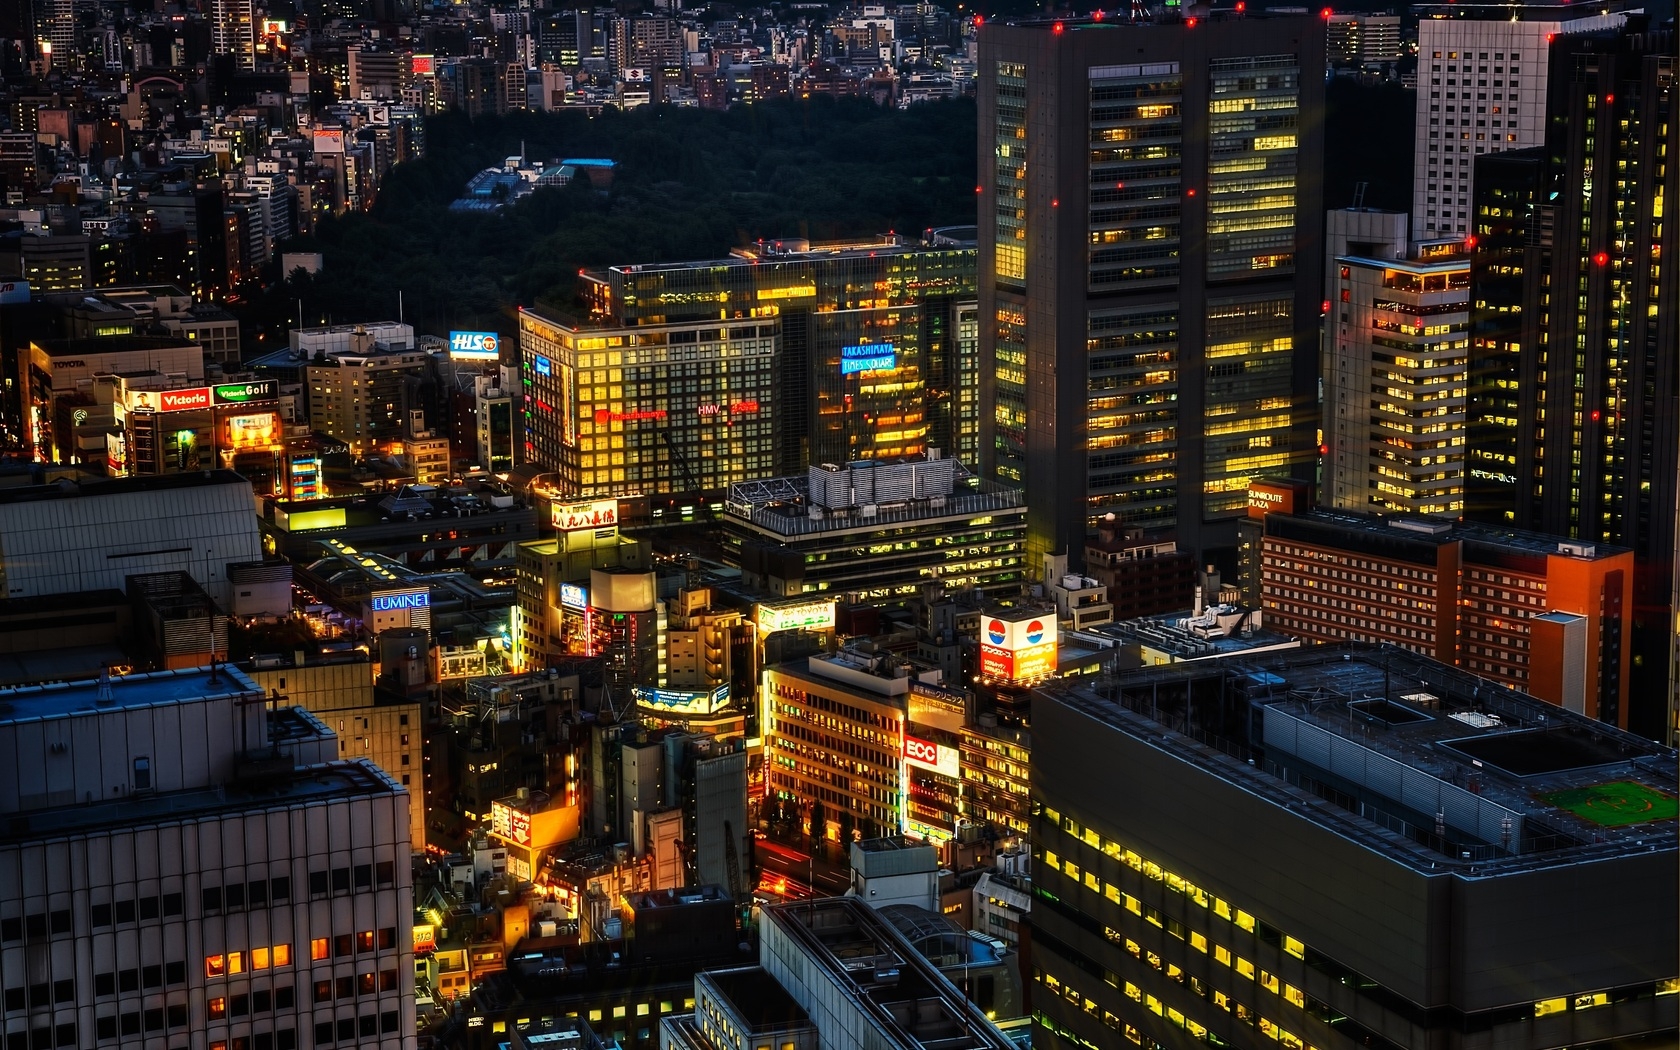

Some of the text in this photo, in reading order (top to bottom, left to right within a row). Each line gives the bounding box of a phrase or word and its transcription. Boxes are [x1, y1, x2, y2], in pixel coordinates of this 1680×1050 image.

[842, 344, 893, 357] TAKASHIMAYA
[53, 360, 86, 369] TOYOTA
[844, 357, 893, 373] TIMES SQUARE
[220, 383, 269, 398] Victoria Golf
[164, 393, 206, 406] Victoria
[323, 443, 349, 456] ZARA
[1248, 490, 1282, 503] SUNROUTE
[1248, 499, 1269, 509] PLAZA
[797, 604, 829, 616] TOYOTA
[935, 690, 963, 704] クリニック
[906, 739, 935, 762] ECC
